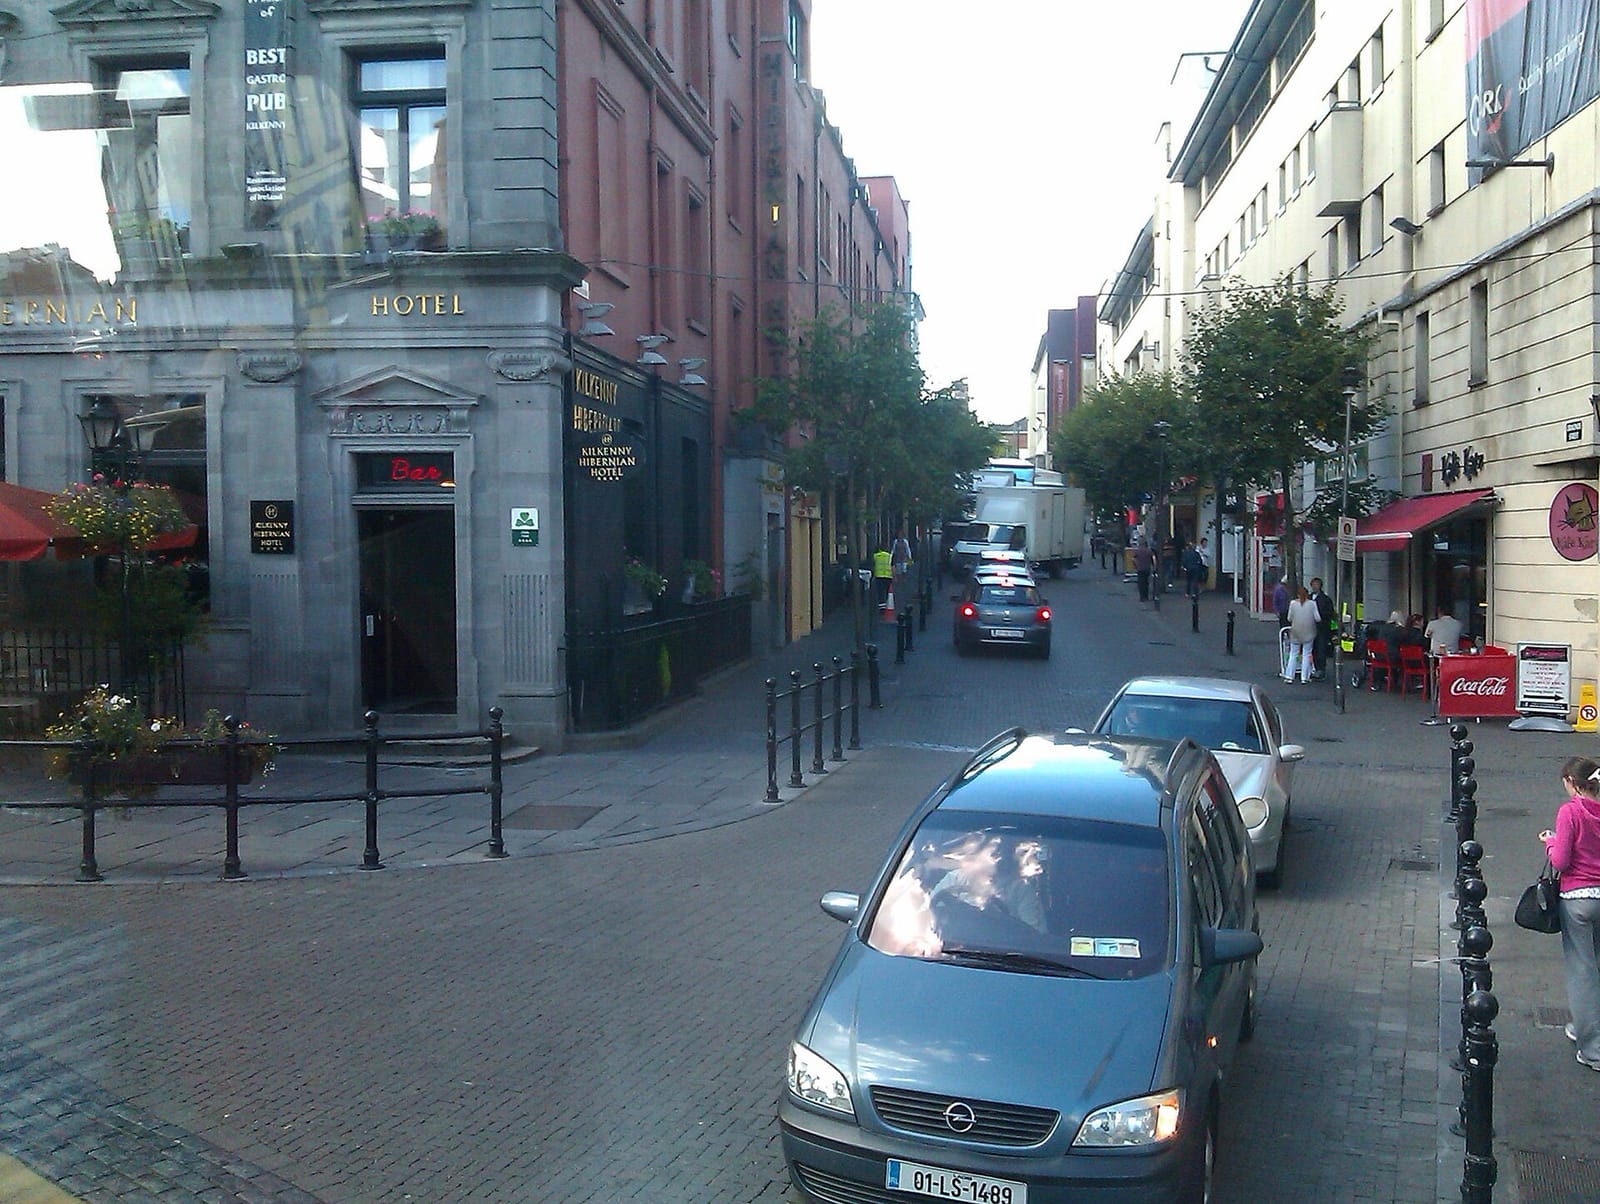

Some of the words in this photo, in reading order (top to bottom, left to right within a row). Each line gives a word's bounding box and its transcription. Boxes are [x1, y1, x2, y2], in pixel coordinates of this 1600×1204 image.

[260, 5, 276, 18] of
[246, 48, 286, 65] BEST
[246, 74, 286, 85] GASTRO
[246, 92, 286, 112] PUB
[1, 298, 137, 325] ERNIAN
[371, 294, 464, 316] HOTEL
[575, 368, 618, 406] KILKENNY
[582, 447, 632, 457] KILKENNY
[391, 457, 442, 480] Bar
[579, 457, 636, 467] HIBERNIAN
[590, 468, 624, 477] HOTEL
[254, 530, 290, 538] HIBERNIAN
[1450, 677, 1509, 696] Coca-Cola
[913, 1170, 1012, 1204] 01-LS-1489
